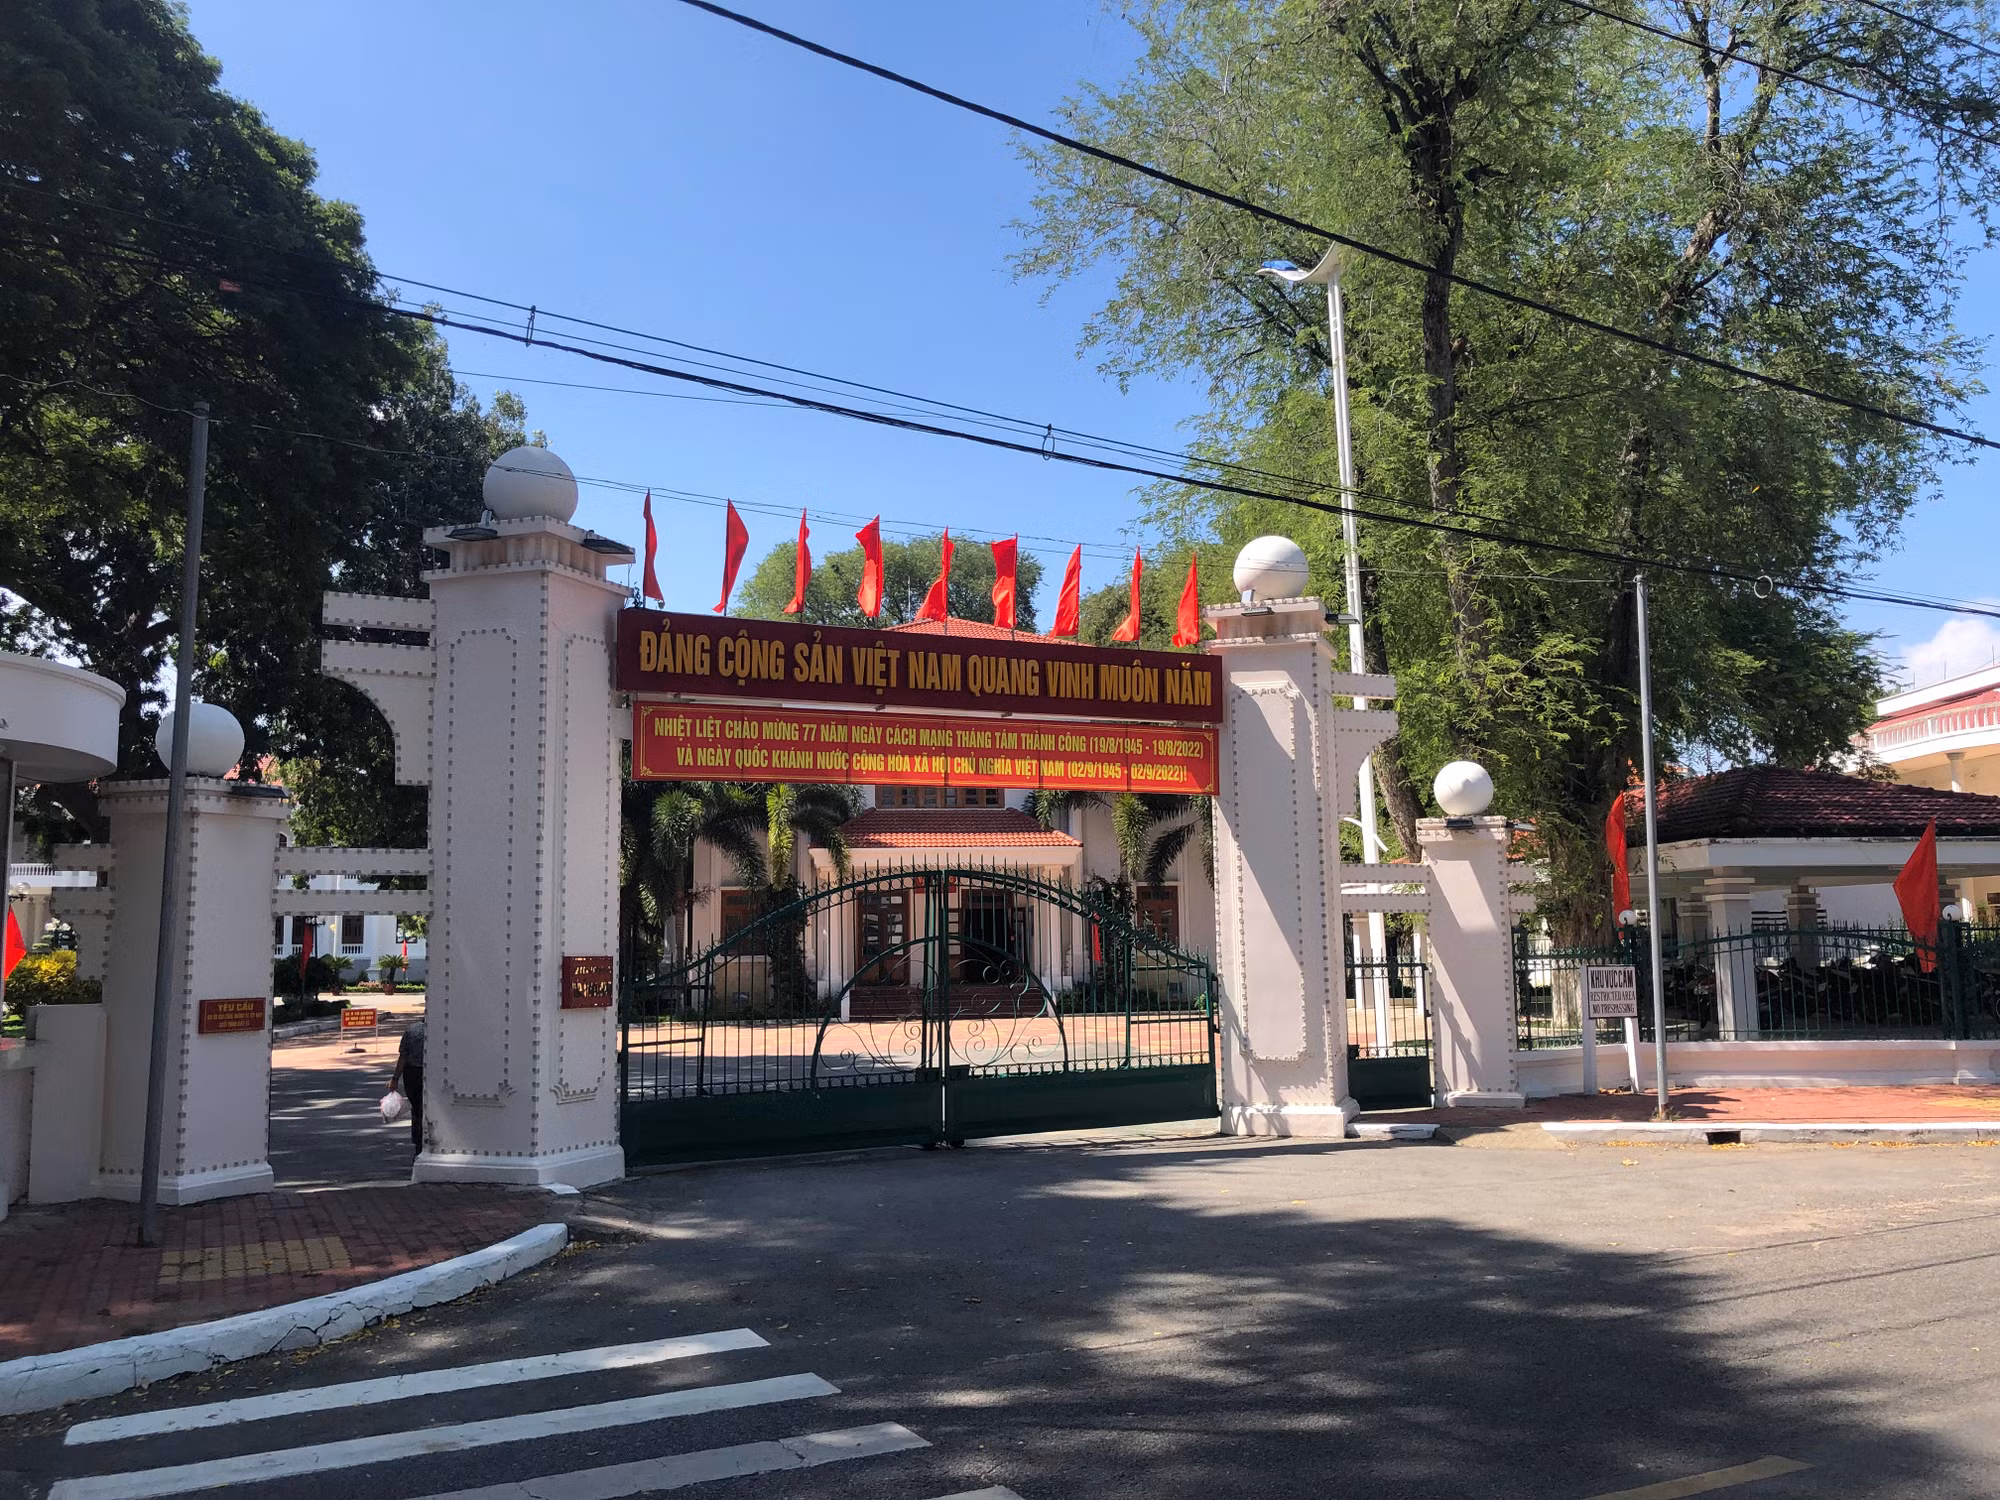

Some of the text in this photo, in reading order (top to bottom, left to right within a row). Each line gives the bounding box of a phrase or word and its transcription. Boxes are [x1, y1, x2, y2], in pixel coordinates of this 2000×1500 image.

[639, 617, 1212, 706] ĐẢNG CỘNG SẢN VIỆT NAM QUANG VINH MUÔN NĂM
[654, 714, 693, 741] NHIỆT
[695, 715, 722, 742] LIỆT
[725, 717, 759, 739] CHÀO
[762, 718, 800, 741] MỪNG
[802, 723, 817, 742] 77
[820, 721, 848, 743] NĂM
[851, 722, 883, 744] NGÀY
[885, 723, 917, 746] CÁCH
[919, 728, 953, 751] MẠNG
[956, 727, 992, 748] THÁNG
[994, 728, 1018, 750] TÁM
[1020, 730, 1056, 751] THÀNH
[1058, 732, 1087, 752] CÔNG
[1089, 736, 1143, 755] (19/8/1945
[1152, 739, 1204, 759] 19/8/2022)
[676, 743, 694, 766] VÀ
[697, 743, 732, 767] NGÀY
[735, 742, 769, 770] QUỐC
[771, 746, 814, 769] KHÁNH
[816, 748, 850, 770] NƯỚC
[852, 749, 885, 775] CỘNG
[887, 750, 911, 772] HÒA
[913, 752, 929, 773] XÃ
[931, 752, 951, 777] HỘI
[953, 751, 976, 774] CHỦ
[978, 754, 1013, 775] NGHĨA
[1014, 755, 1038, 780] VIỆT
[1039, 759, 1065, 777] NAM
[1067, 760, 1121, 779] (02/9/1945
[1130, 763, 1188, 783] 02/9/2022)!
[1590, 970, 1604, 988] KHU
[1590, 991, 1635, 1001] RESTRICTED AREA
[1592, 1004, 1634, 1014] NO TRESPASSING
